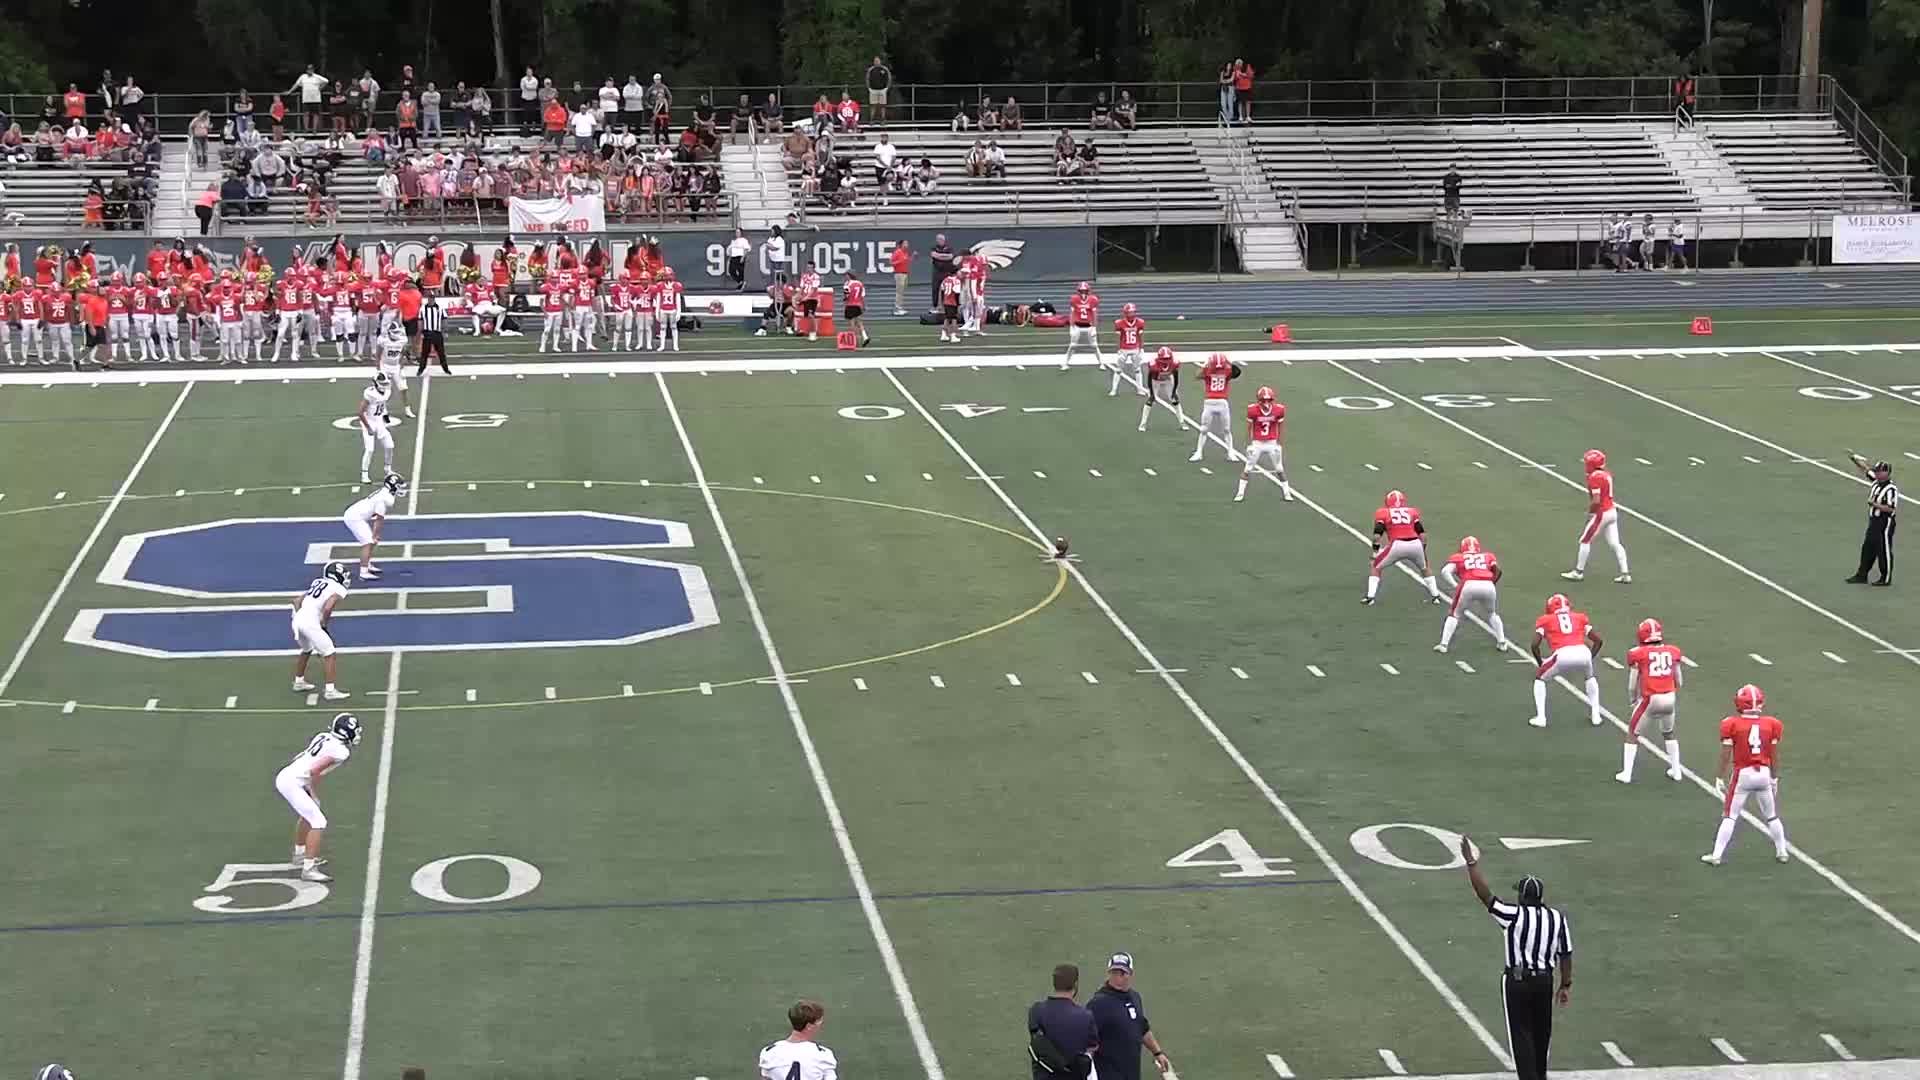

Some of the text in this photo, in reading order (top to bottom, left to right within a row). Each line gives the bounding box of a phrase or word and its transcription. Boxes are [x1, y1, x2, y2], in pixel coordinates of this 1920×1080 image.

[1125, 331, 1137, 344] 16
[1259, 421, 1270, 436] 3
[1388, 507, 1413, 524] 55
[1463, 552, 1487, 569] 22
[1556, 613, 1572, 635] 8
[1648, 651, 1673, 677] 20
[1747, 723, 1761, 755] 4
